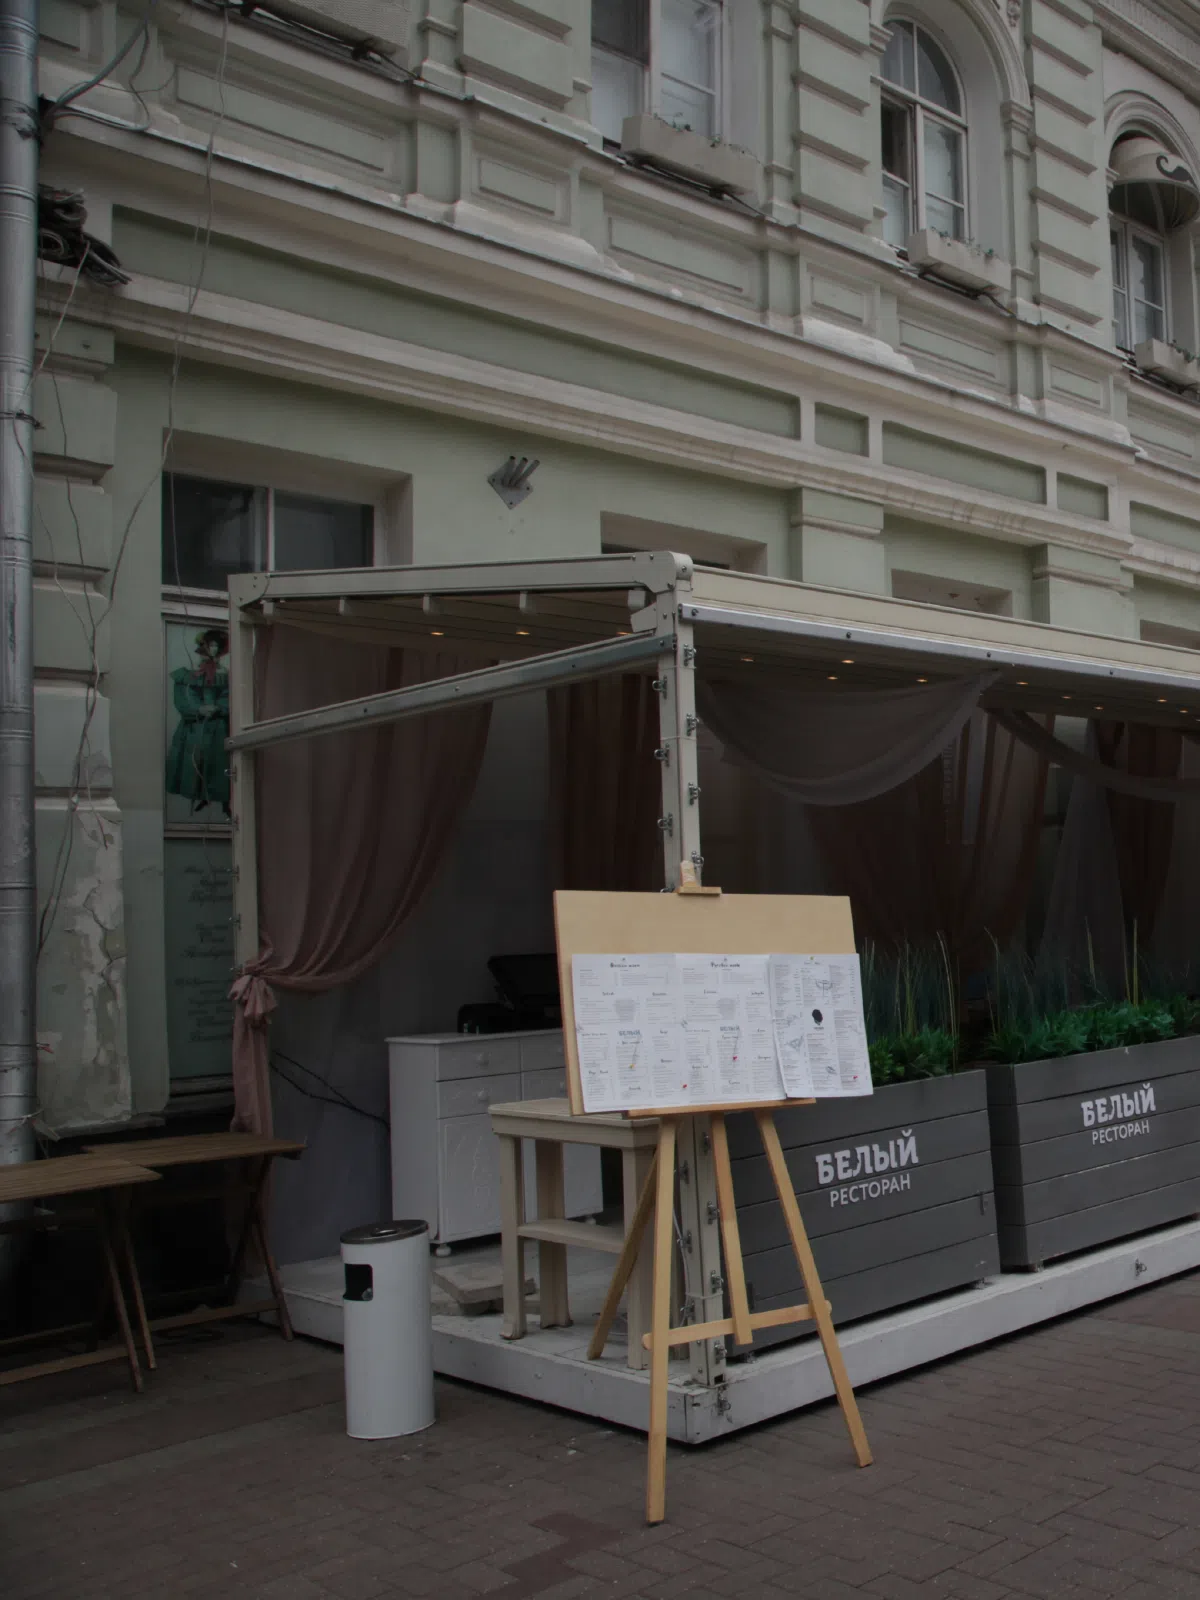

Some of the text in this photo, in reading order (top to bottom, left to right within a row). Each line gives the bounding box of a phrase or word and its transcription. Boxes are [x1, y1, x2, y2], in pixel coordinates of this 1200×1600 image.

[1081, 1082, 1157, 1127] БЕЛЫЙ
[1092, 1119, 1150, 1145] РЕСТОРАН
[815, 1129, 919, 1184] БЕЛЫЙ
[830, 1173, 911, 1208] РЕСТОРАН
